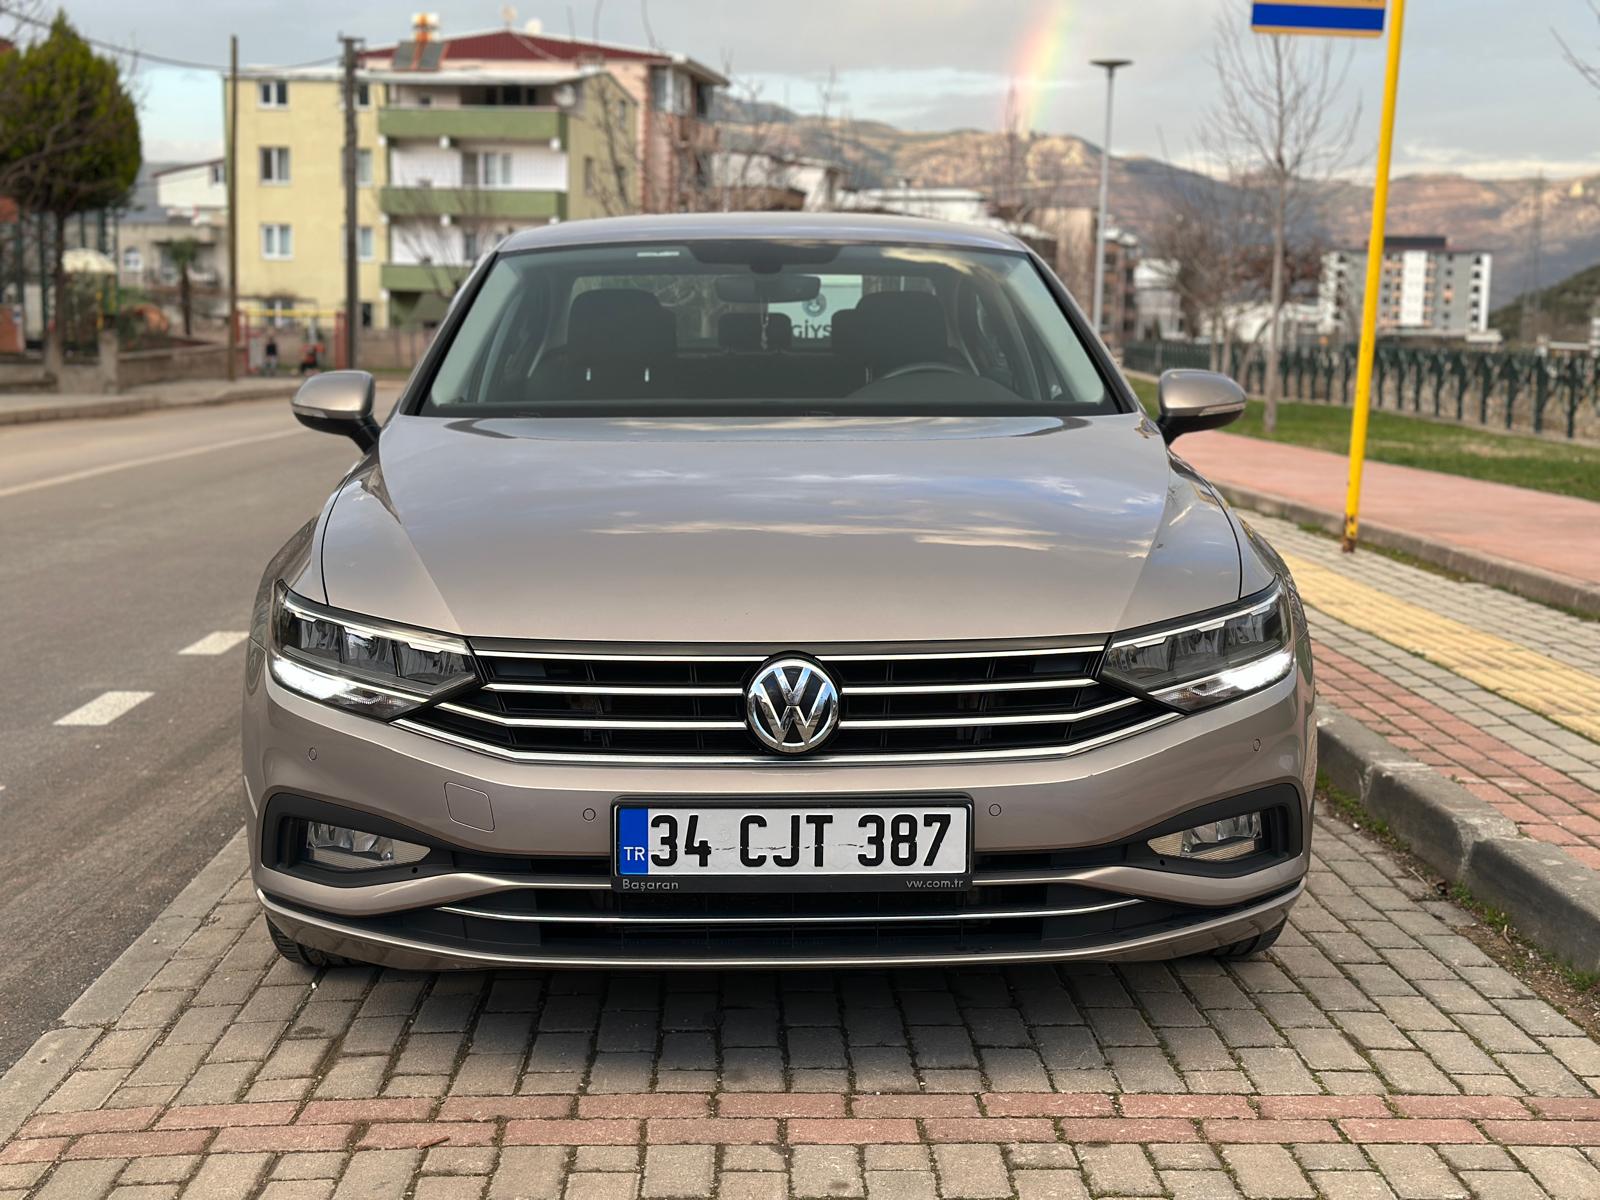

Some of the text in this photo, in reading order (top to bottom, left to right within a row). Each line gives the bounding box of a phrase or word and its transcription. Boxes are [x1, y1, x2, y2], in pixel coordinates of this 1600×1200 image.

[750, 662, 837, 751] VW
[650, 813, 952, 868] 34 CJT 387
[623, 846, 645, 861] TR
[622, 878, 679, 892] Başaran
[905, 878, 964, 889] vw.com.tr
